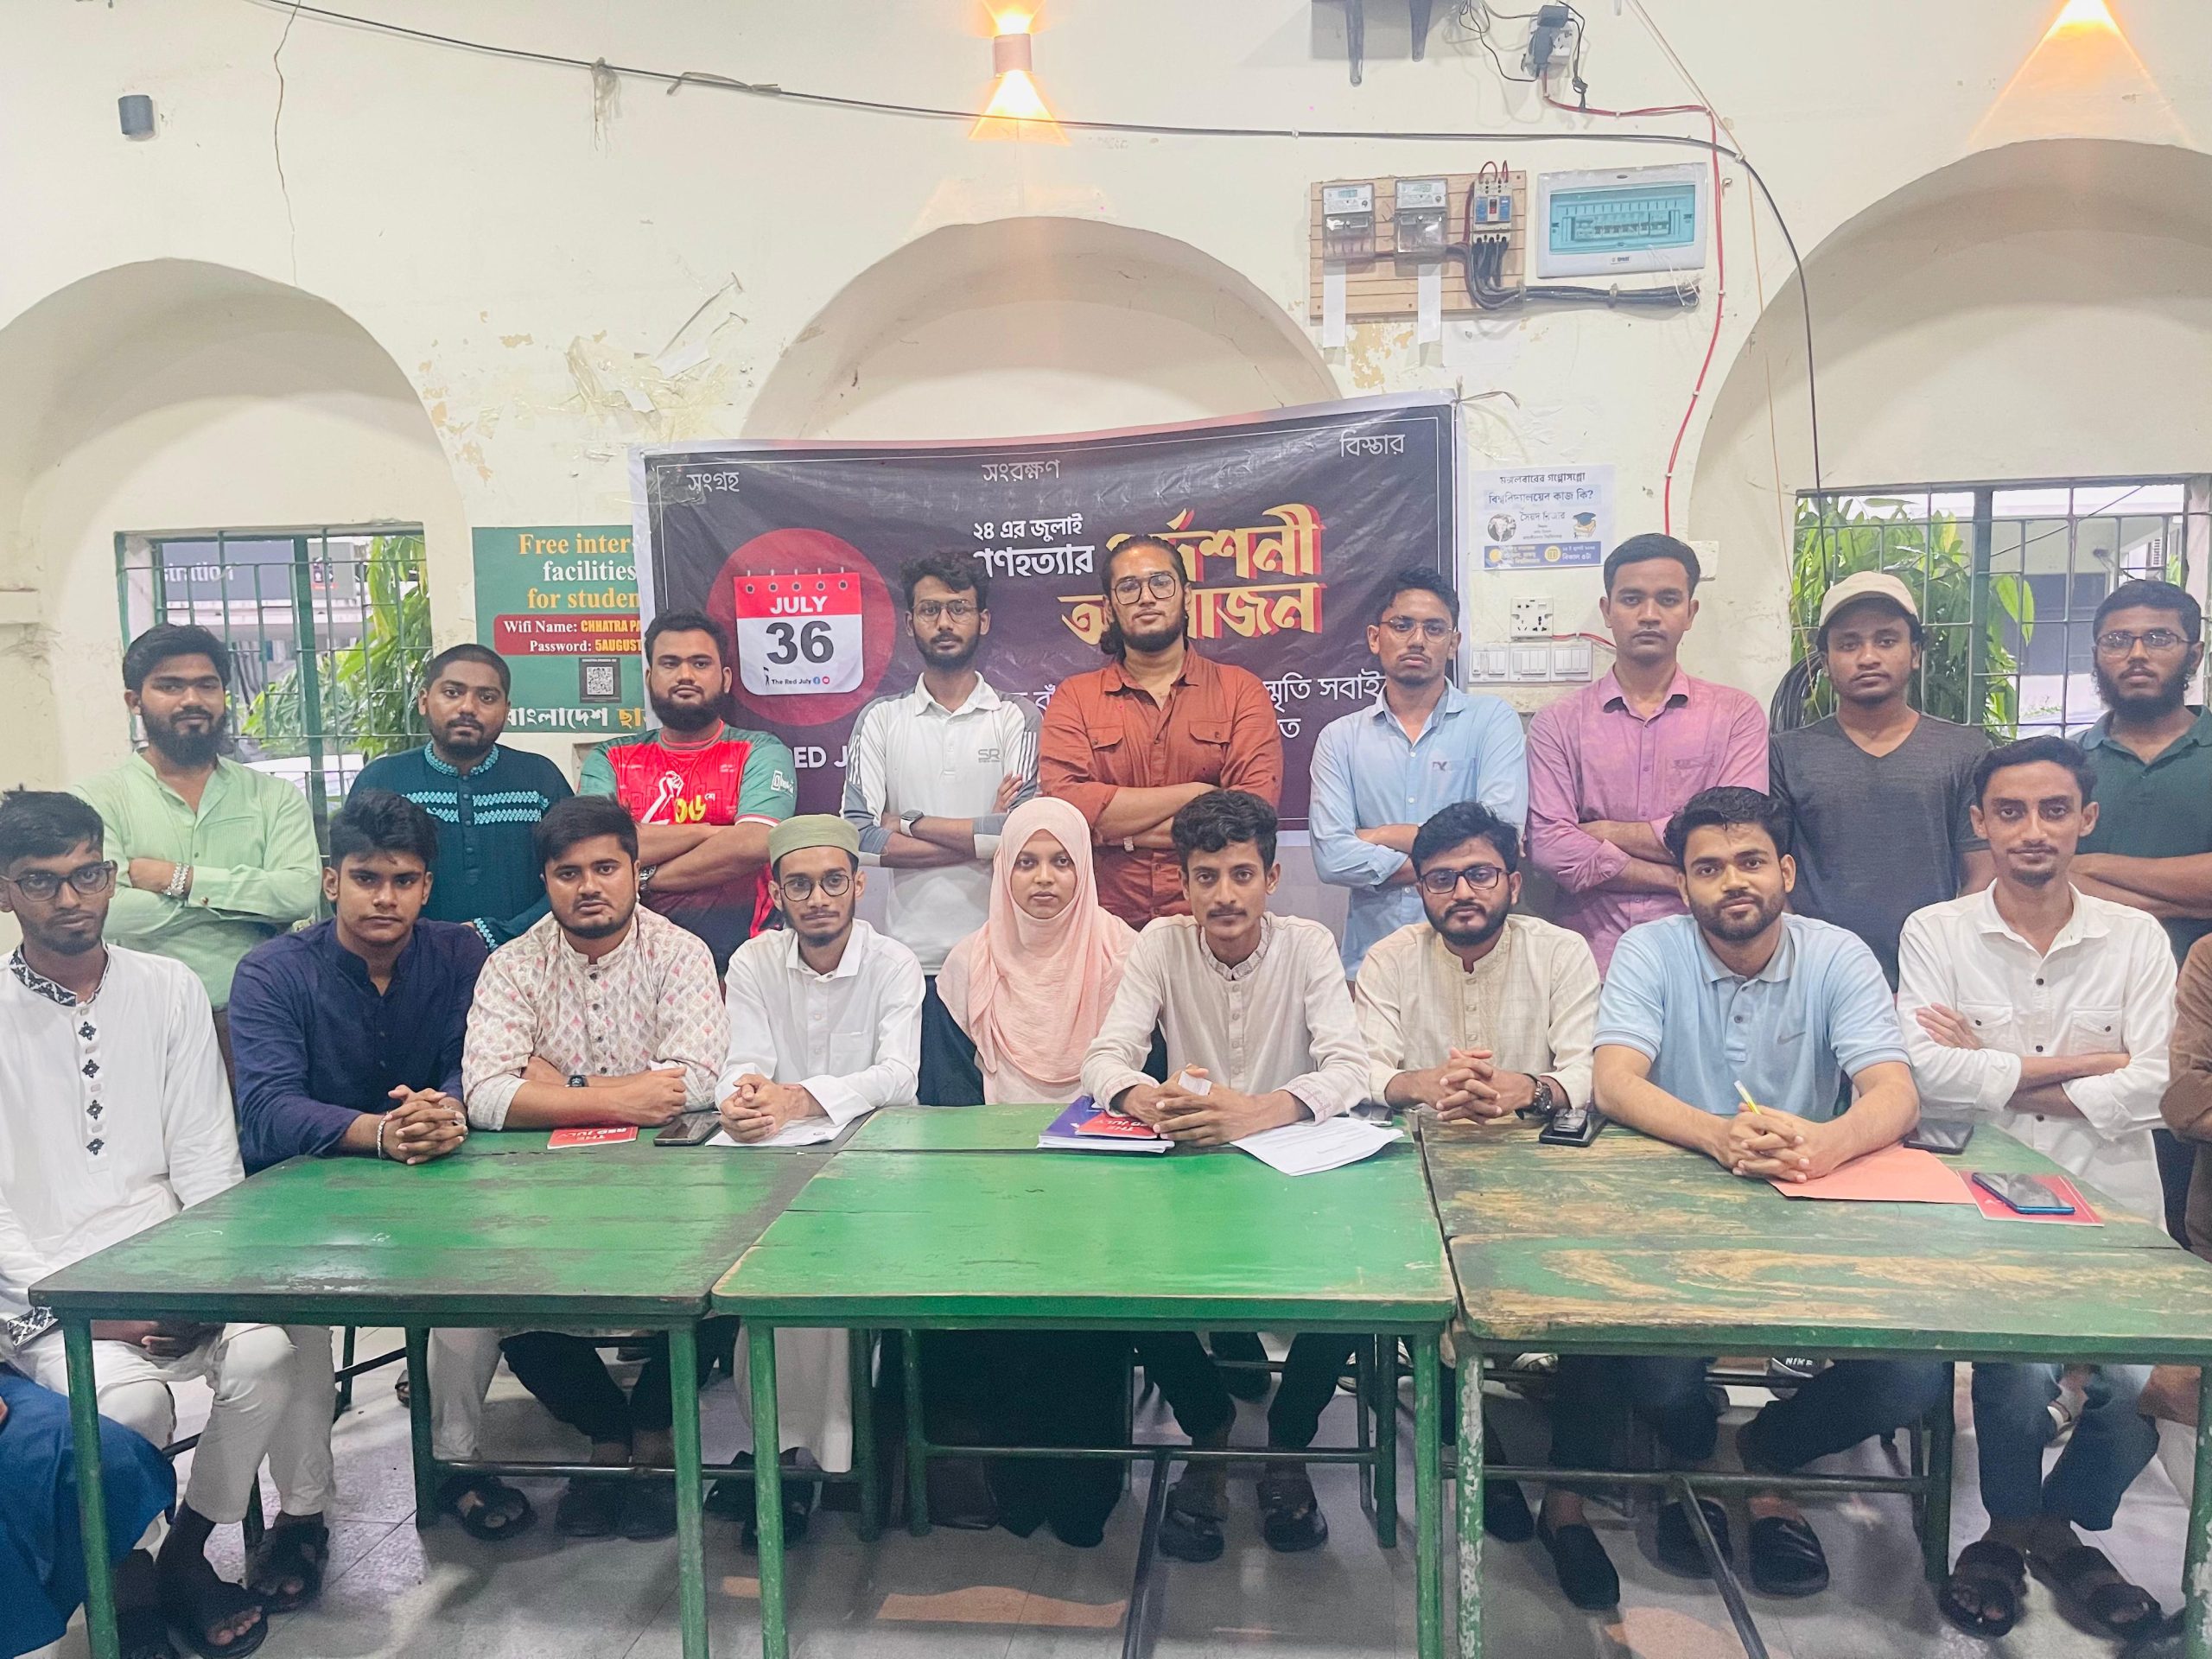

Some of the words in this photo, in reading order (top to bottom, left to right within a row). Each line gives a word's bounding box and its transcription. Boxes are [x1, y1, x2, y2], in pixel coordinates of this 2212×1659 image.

[1339, 429, 1405, 457] বিস্তার
[982, 460, 1060, 481] সংরক্ষণ
[686, 472, 740, 493] সংগ্রহ
[1554, 492, 1573, 500] কাজ
[1576, 488, 1593, 500] কি?
[973, 522, 995, 541] ২৪
[1000, 521, 1027, 539] এর
[1029, 513, 1084, 543] জুলাই
[518, 533, 569, 555] Free
[575, 532, 633, 554] inter
[543, 560, 637, 582] facilities
[527, 588, 561, 609] for
[770, 596, 828, 614] JULY
[504, 620, 532, 633] Wifi
[535, 620, 577, 632] Name:
[581, 620, 628, 632] CHHATRA
[530, 640, 592, 652] Password:
[766, 620, 834, 664] 36
[1318, 669, 1387, 701] সবাই
[507, 707, 608, 729] বাংলাদেশ
[792, 746, 827, 768] ED
[978, 748, 1001, 760] SR
[1785, 1357, 1813, 1366] NIKE
